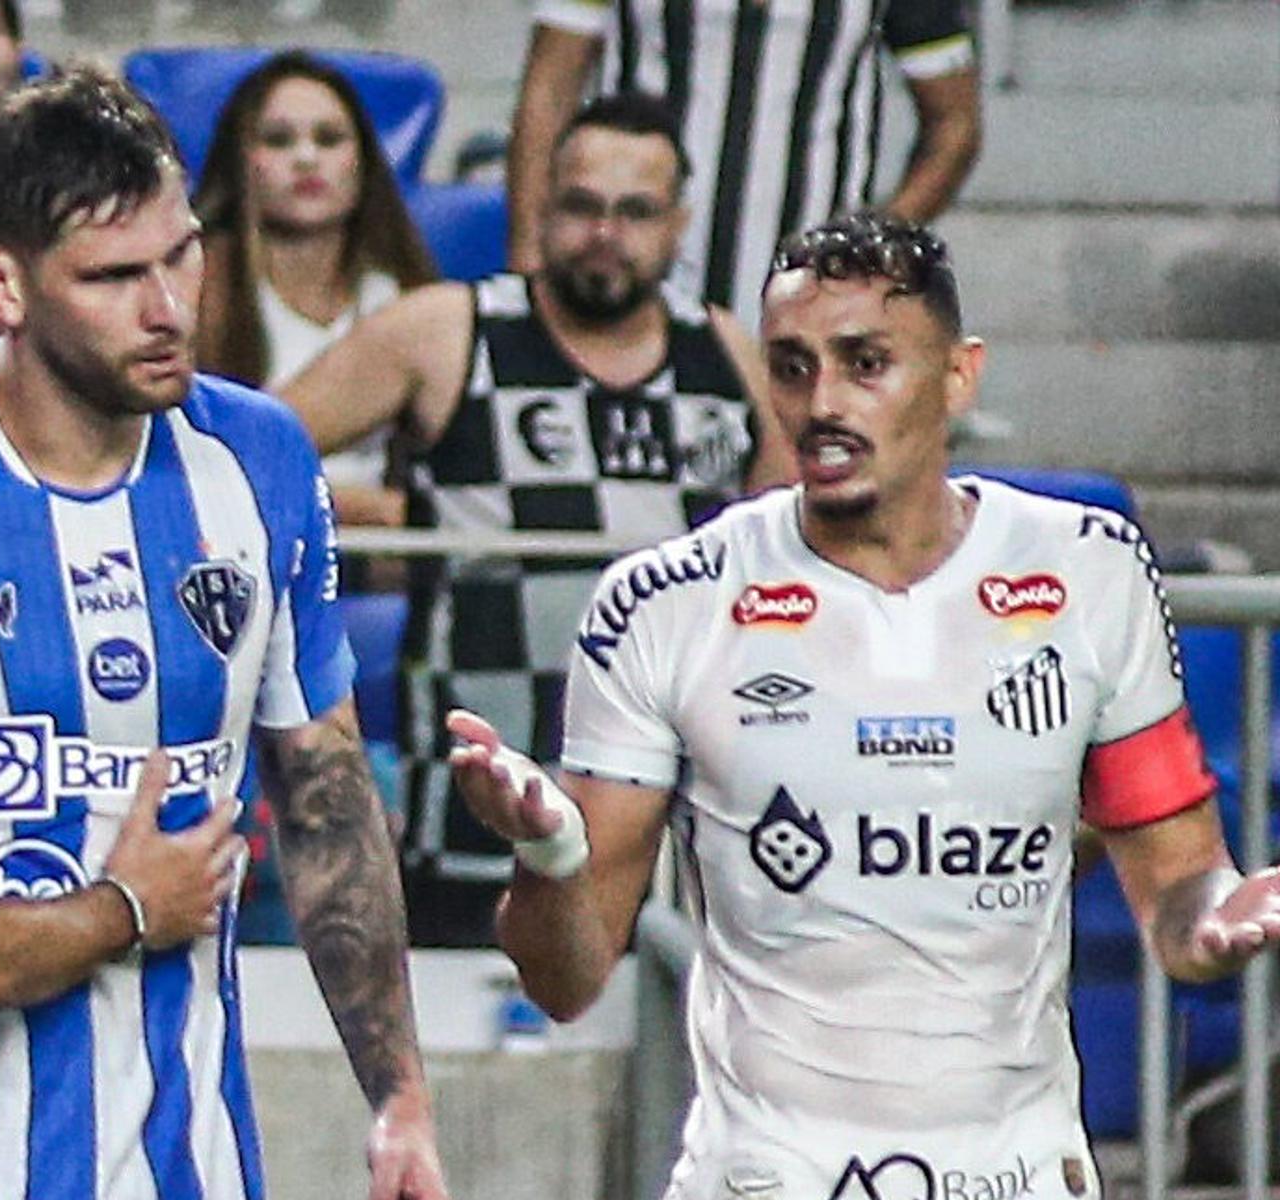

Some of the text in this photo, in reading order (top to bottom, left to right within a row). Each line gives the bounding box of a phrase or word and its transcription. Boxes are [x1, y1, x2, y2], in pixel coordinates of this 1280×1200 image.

[858, 738, 953, 755] BOND
[858, 814, 1054, 876] blaze
[967, 879, 1051, 911] .com
